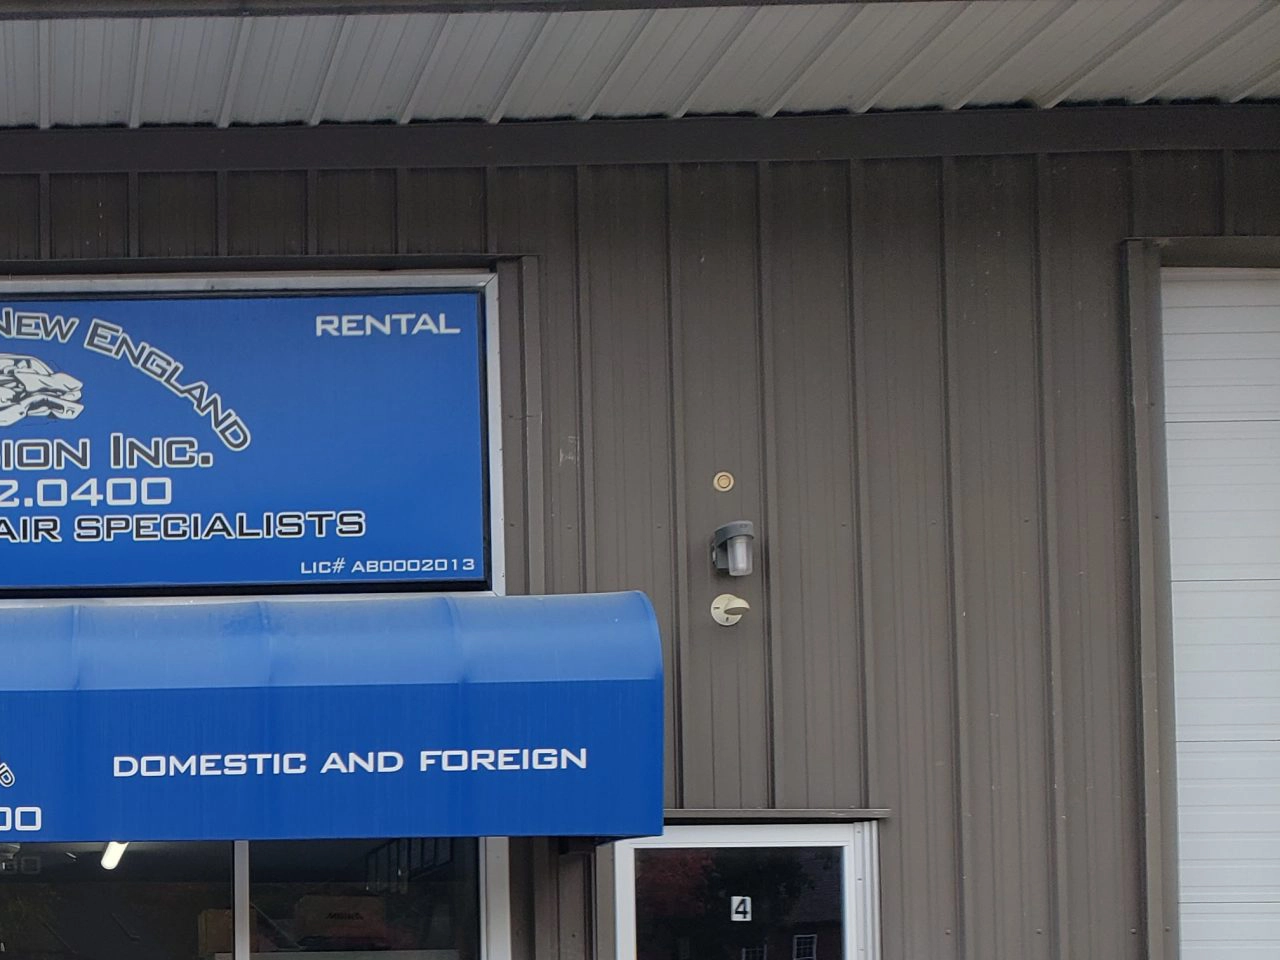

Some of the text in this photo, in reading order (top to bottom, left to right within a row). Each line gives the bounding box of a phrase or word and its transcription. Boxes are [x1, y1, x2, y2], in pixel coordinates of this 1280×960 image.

[315, 313, 461, 337] RENTAL
[83, 318, 252, 452] ENGLAND
[110, 432, 214, 469] INC.
[73, 510, 367, 543] SPECIALISTS
[300, 557, 346, 575] LIC#
[112, 747, 588, 777] DOMESTIC AND FOREIGN
[734, 898, 749, 919] 4
